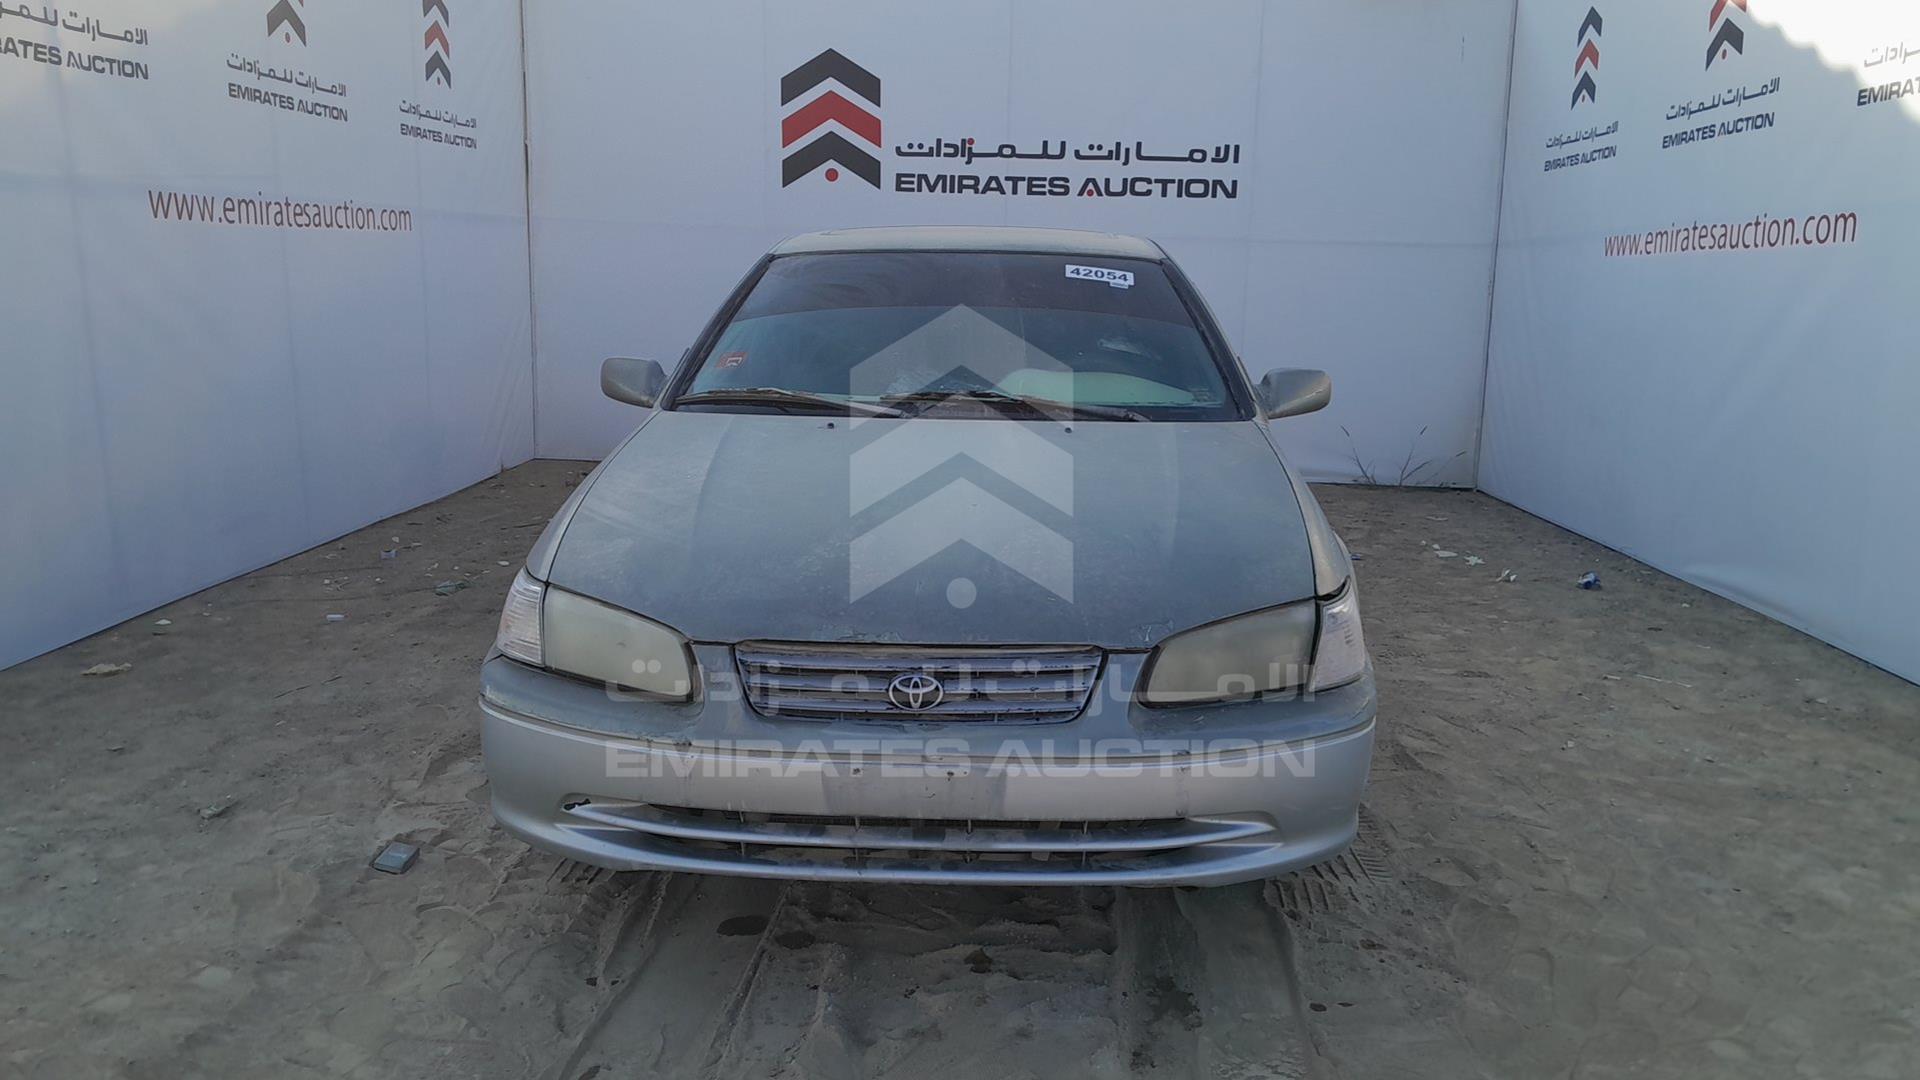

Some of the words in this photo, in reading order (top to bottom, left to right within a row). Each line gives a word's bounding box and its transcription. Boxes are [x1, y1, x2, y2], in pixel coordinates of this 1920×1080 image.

[0, 36, 62, 66] ATES
[66, 50, 149, 80] AUCTION
[228, 82, 295, 111] EMIRATES
[297, 99, 348, 122] AUCTION
[400, 123, 443, 143] EMIRATES
[443, 132, 478, 149] AUCTION
[1662, 123, 1717, 149] EMIRATES
[1718, 111, 1775, 137] AUCTION
[895, 137, 1066, 165] للمزادات
[1543, 152, 1581, 172] EMIRATES
[1580, 145, 1618, 165] AUCTION
[895, 173, 1071, 196] EMIRATES
[1076, 177, 1238, 199] AUCTION
[1603, 211, 1857, 257] www.emiratesauction.com
[1069, 267, 1129, 282] 42054
